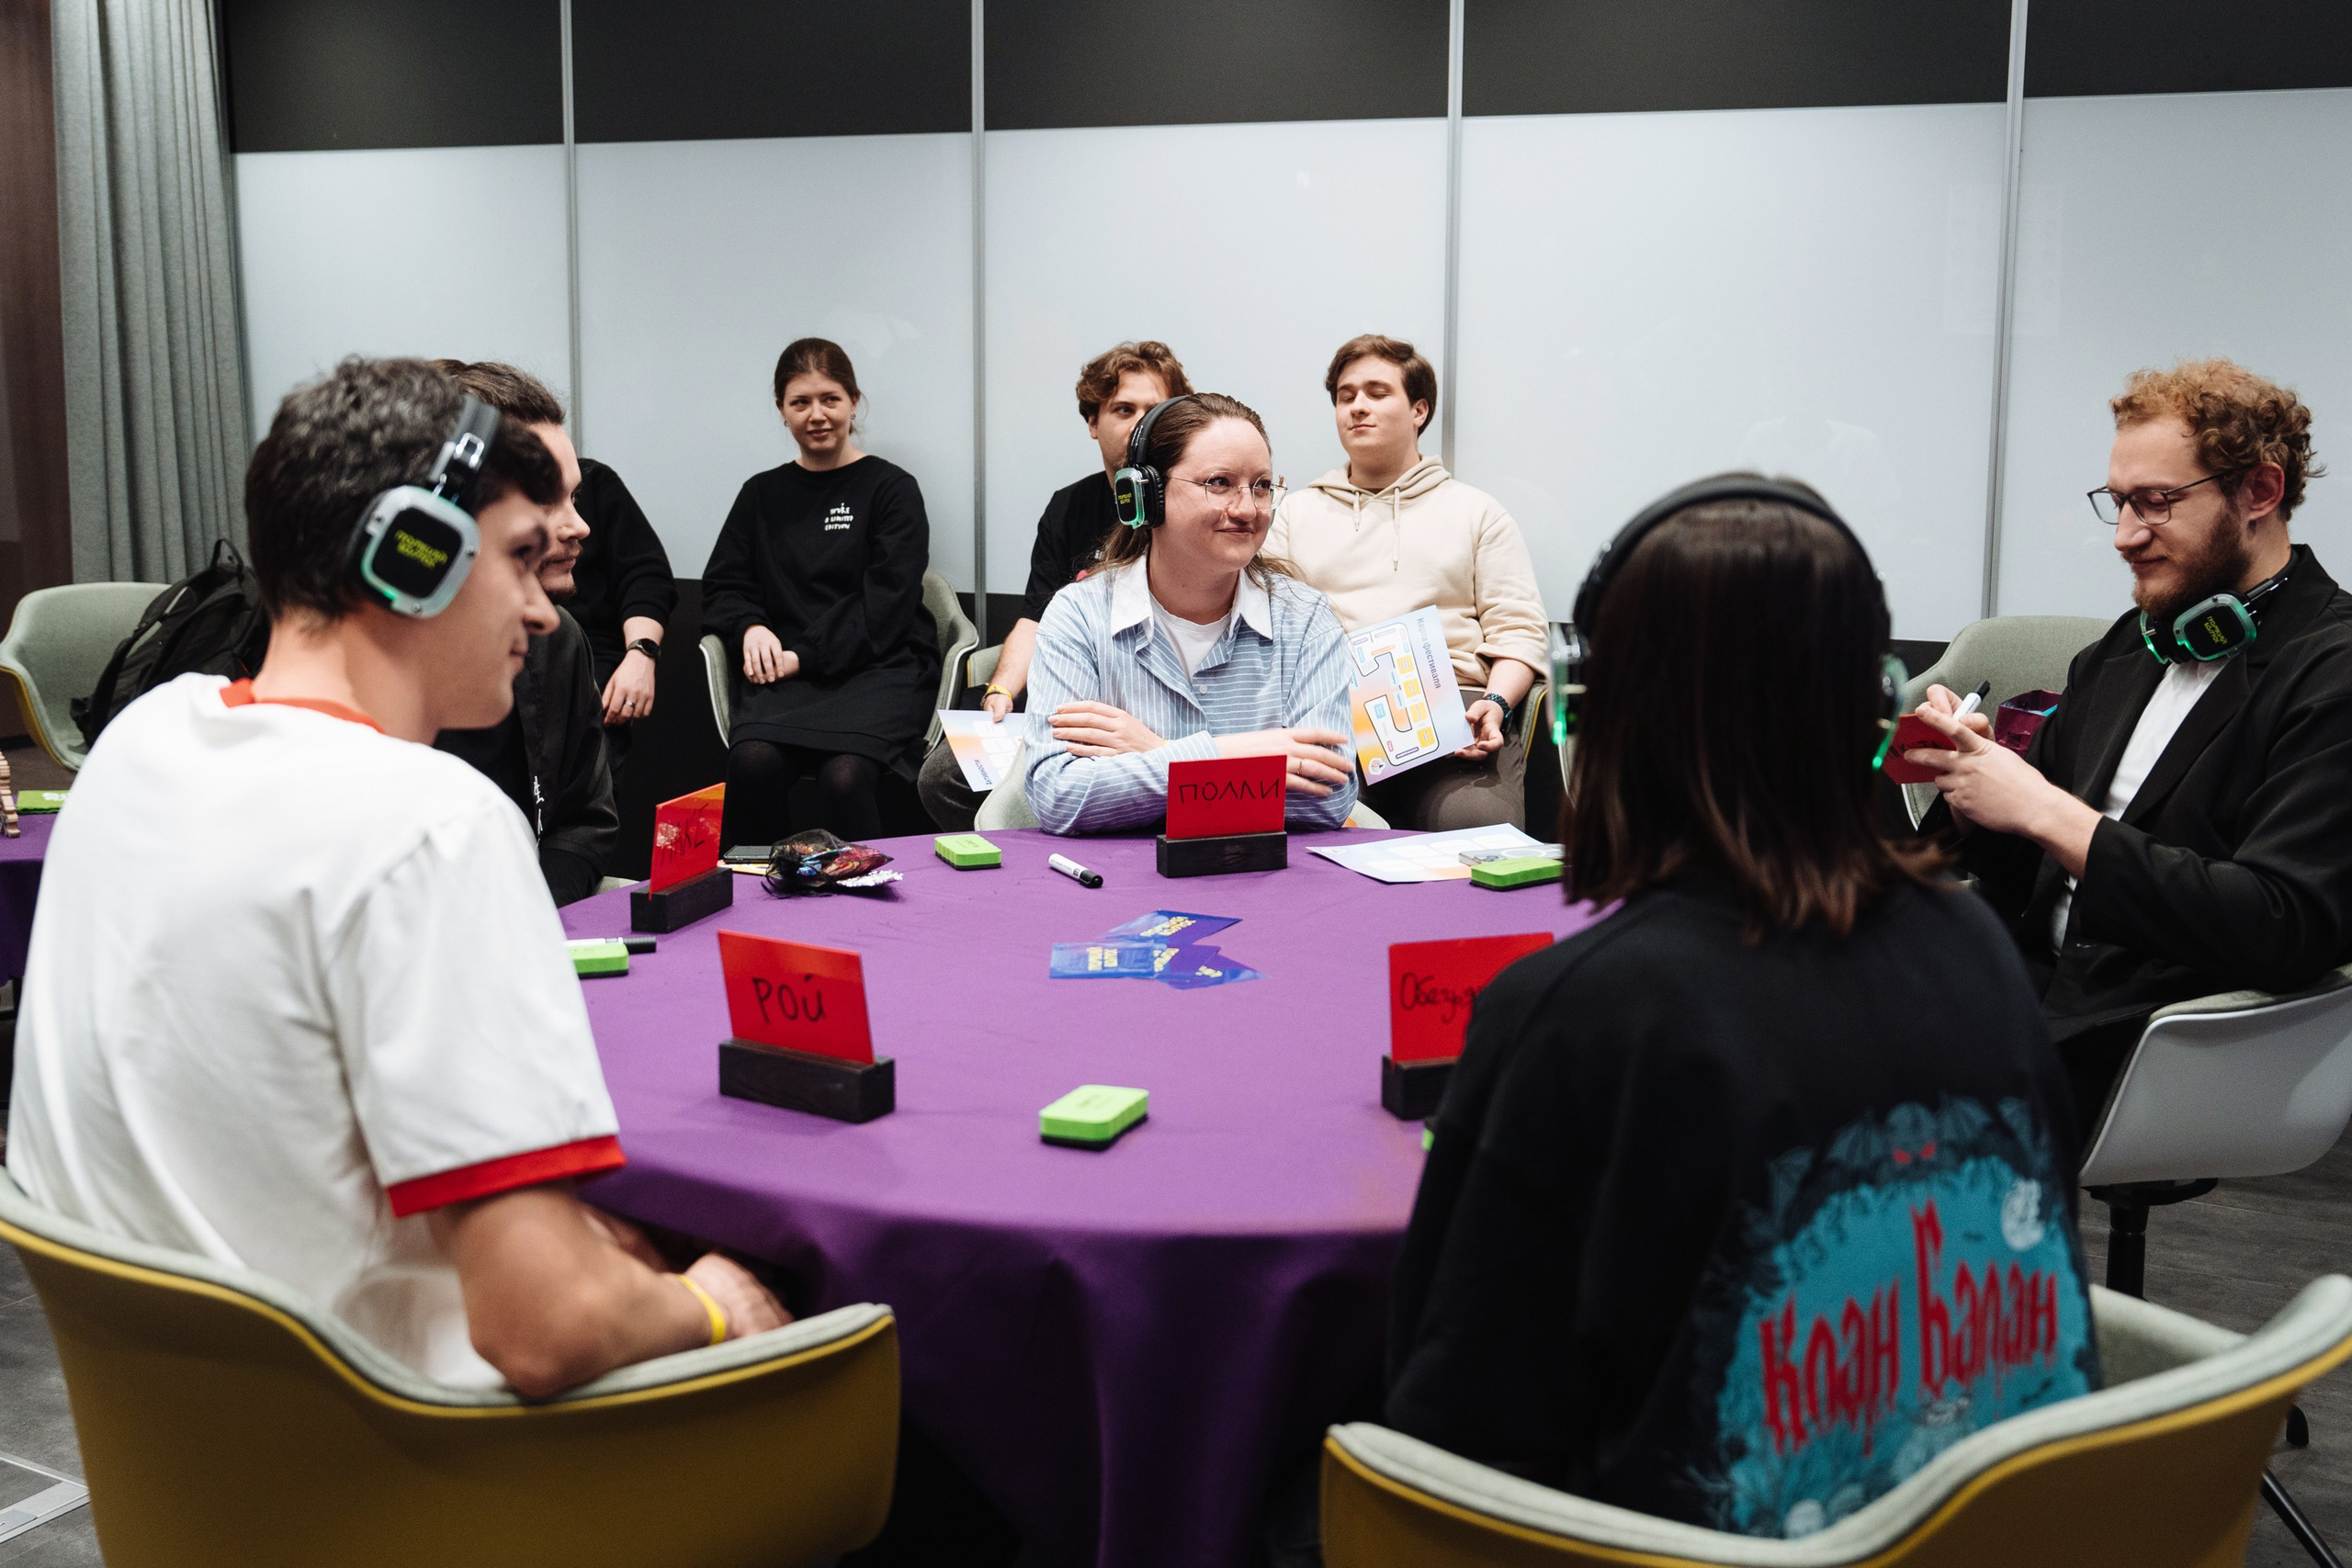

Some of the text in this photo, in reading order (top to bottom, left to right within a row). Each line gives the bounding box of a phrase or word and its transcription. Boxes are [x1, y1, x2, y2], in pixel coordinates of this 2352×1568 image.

[1417, 617, 1442, 689] Карта фестиваля
[1179, 778, 1280, 804] ПОЛЛИ
